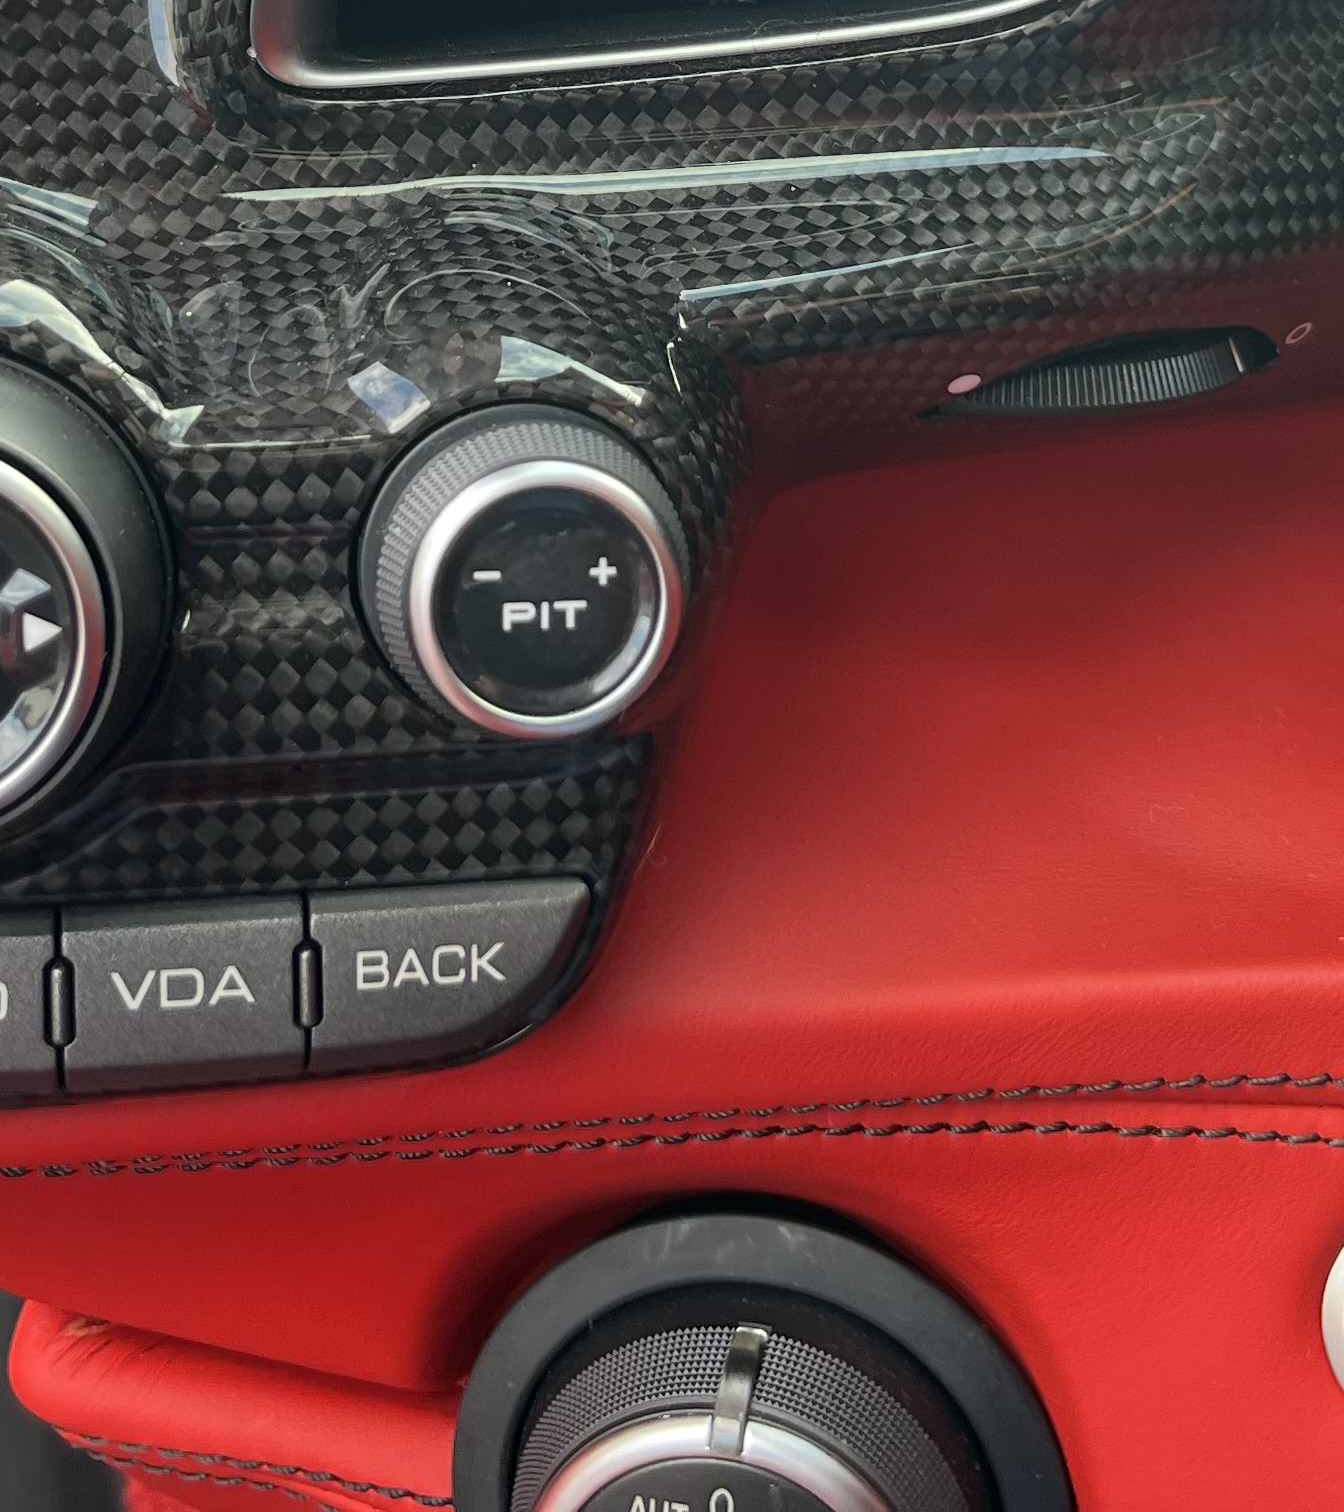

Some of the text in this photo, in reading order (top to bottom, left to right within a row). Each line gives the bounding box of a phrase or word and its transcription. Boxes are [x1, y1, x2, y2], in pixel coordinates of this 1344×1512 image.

[500, 599, 587, 632] PIT
[110, 966, 255, 1010] VDA
[354, 944, 507, 990] BACK
